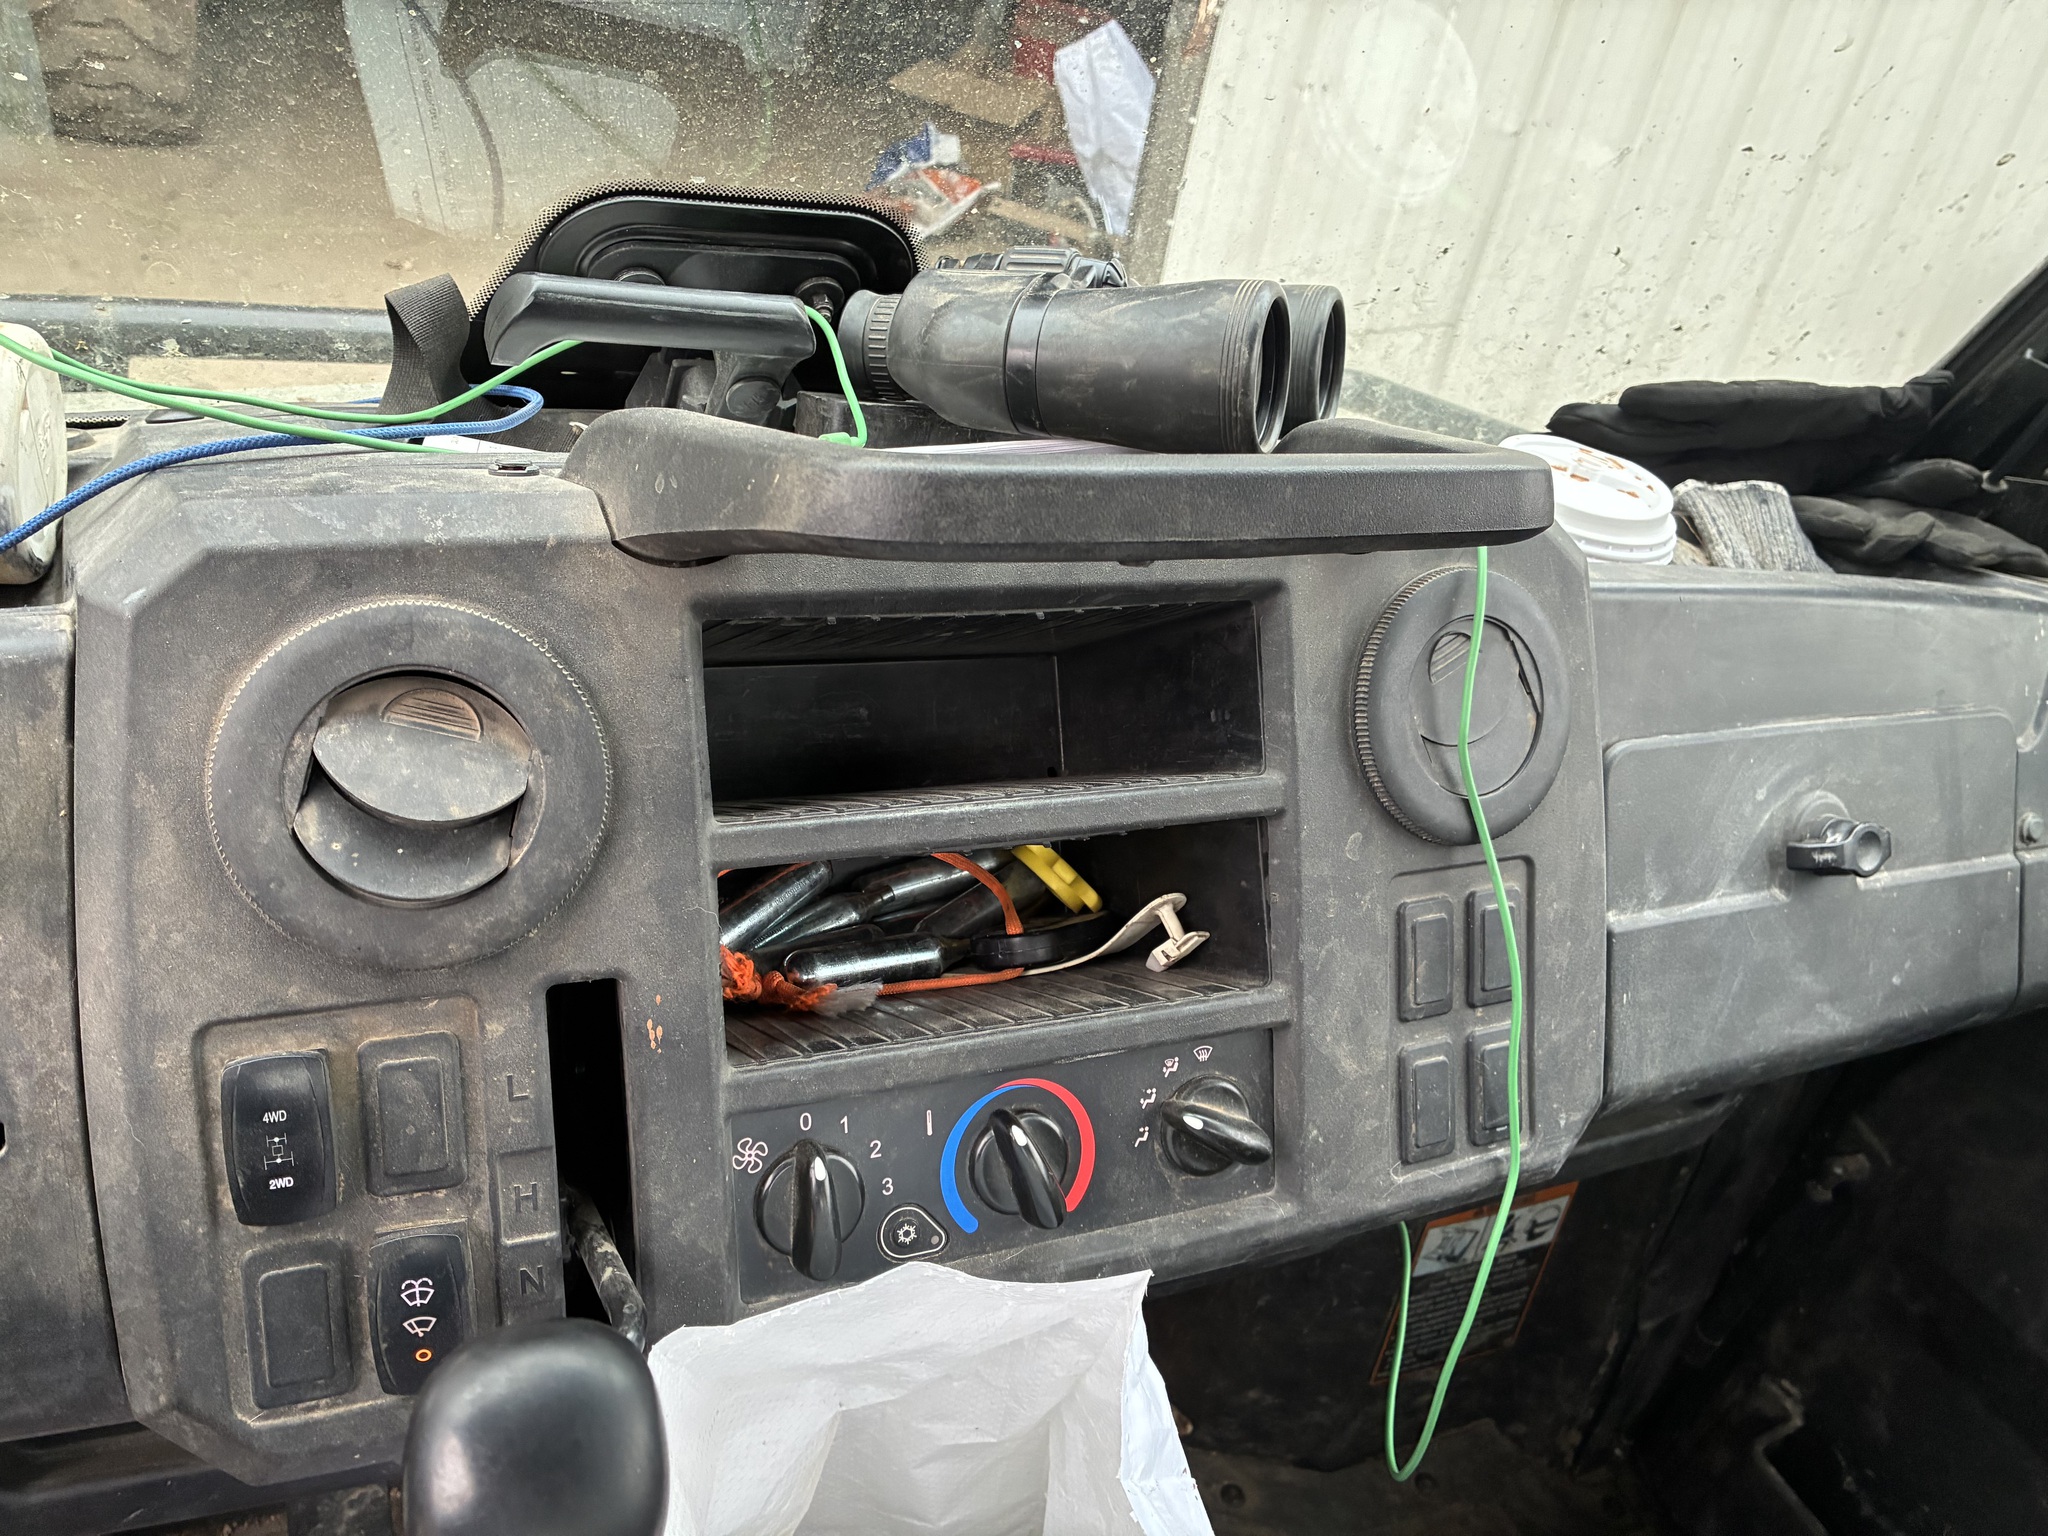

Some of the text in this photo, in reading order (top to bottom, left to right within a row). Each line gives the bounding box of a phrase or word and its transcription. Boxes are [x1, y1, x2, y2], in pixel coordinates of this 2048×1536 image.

[506, 1074, 529, 1102] L
[262, 1109, 287, 1124] 4WD
[799, 1112, 812, 1131] 0
[840, 1115, 849, 1134] 1
[869, 1139, 882, 1159] 2
[268, 1176, 294, 1190] 2WD
[881, 1177, 894, 1196] 3
[513, 1182, 538, 1212] H
[520, 1265, 545, 1296] N
